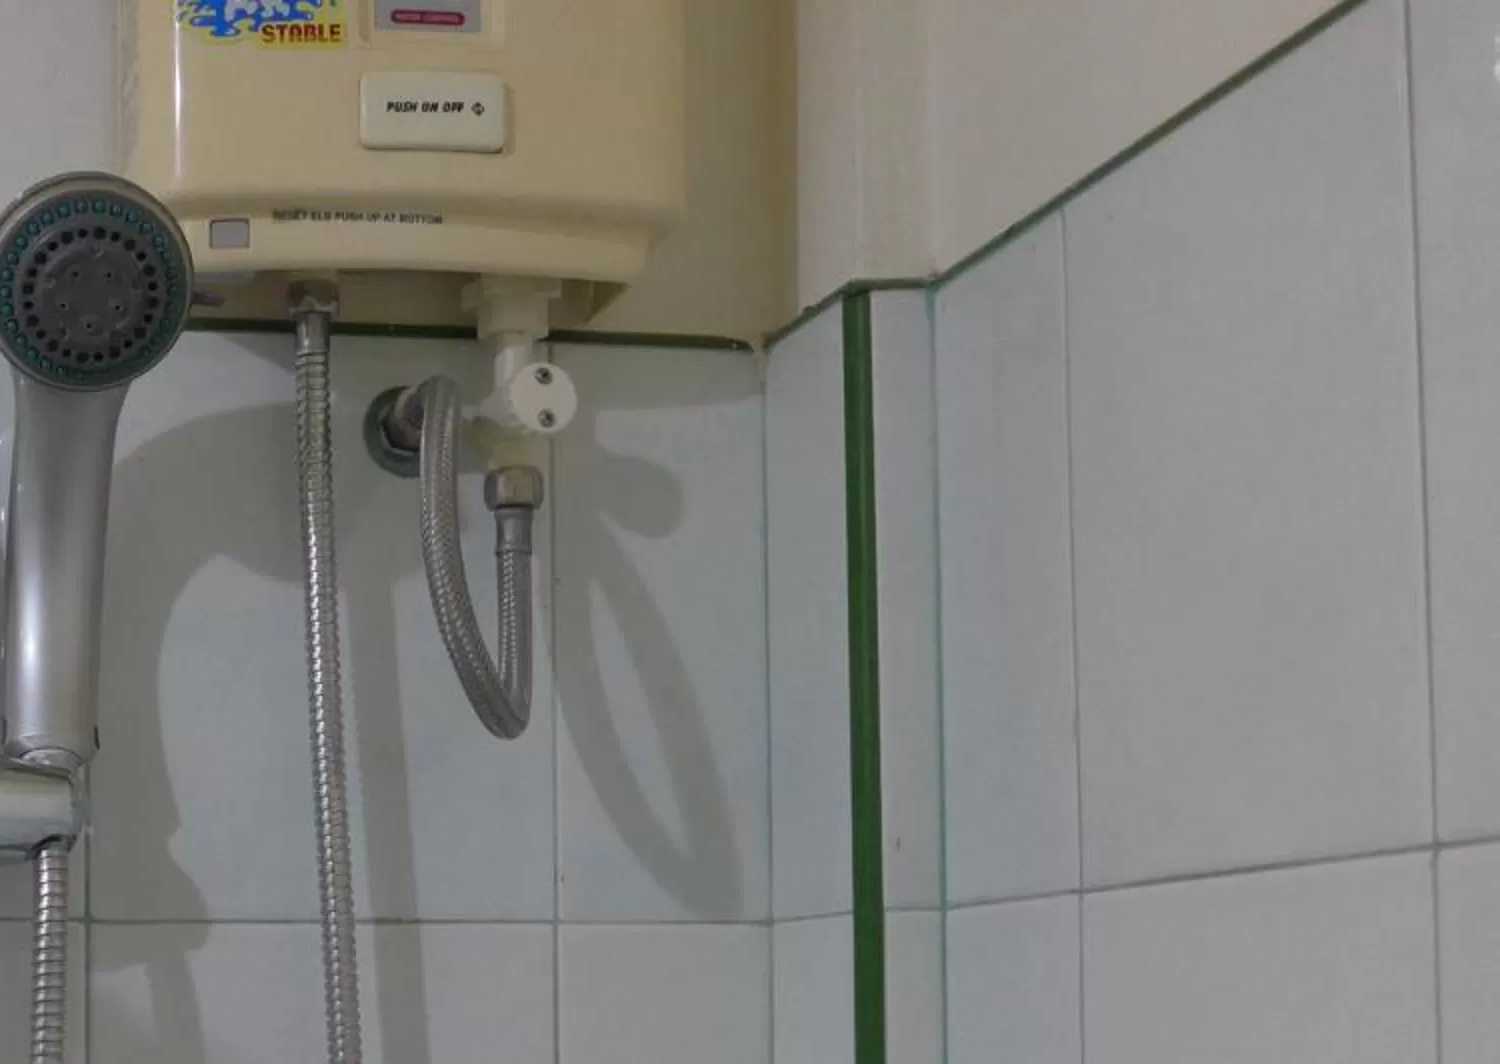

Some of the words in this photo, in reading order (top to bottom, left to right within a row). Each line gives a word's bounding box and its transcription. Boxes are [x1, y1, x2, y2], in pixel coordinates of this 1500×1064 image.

[262, 24, 341, 43] STABLE
[386, 101, 418, 113] PUSH
[421, 101, 439, 113] ON
[442, 101, 464, 113] OFF
[272, 209, 307, 221] RESET
[335, 211, 364, 222] PUSH
